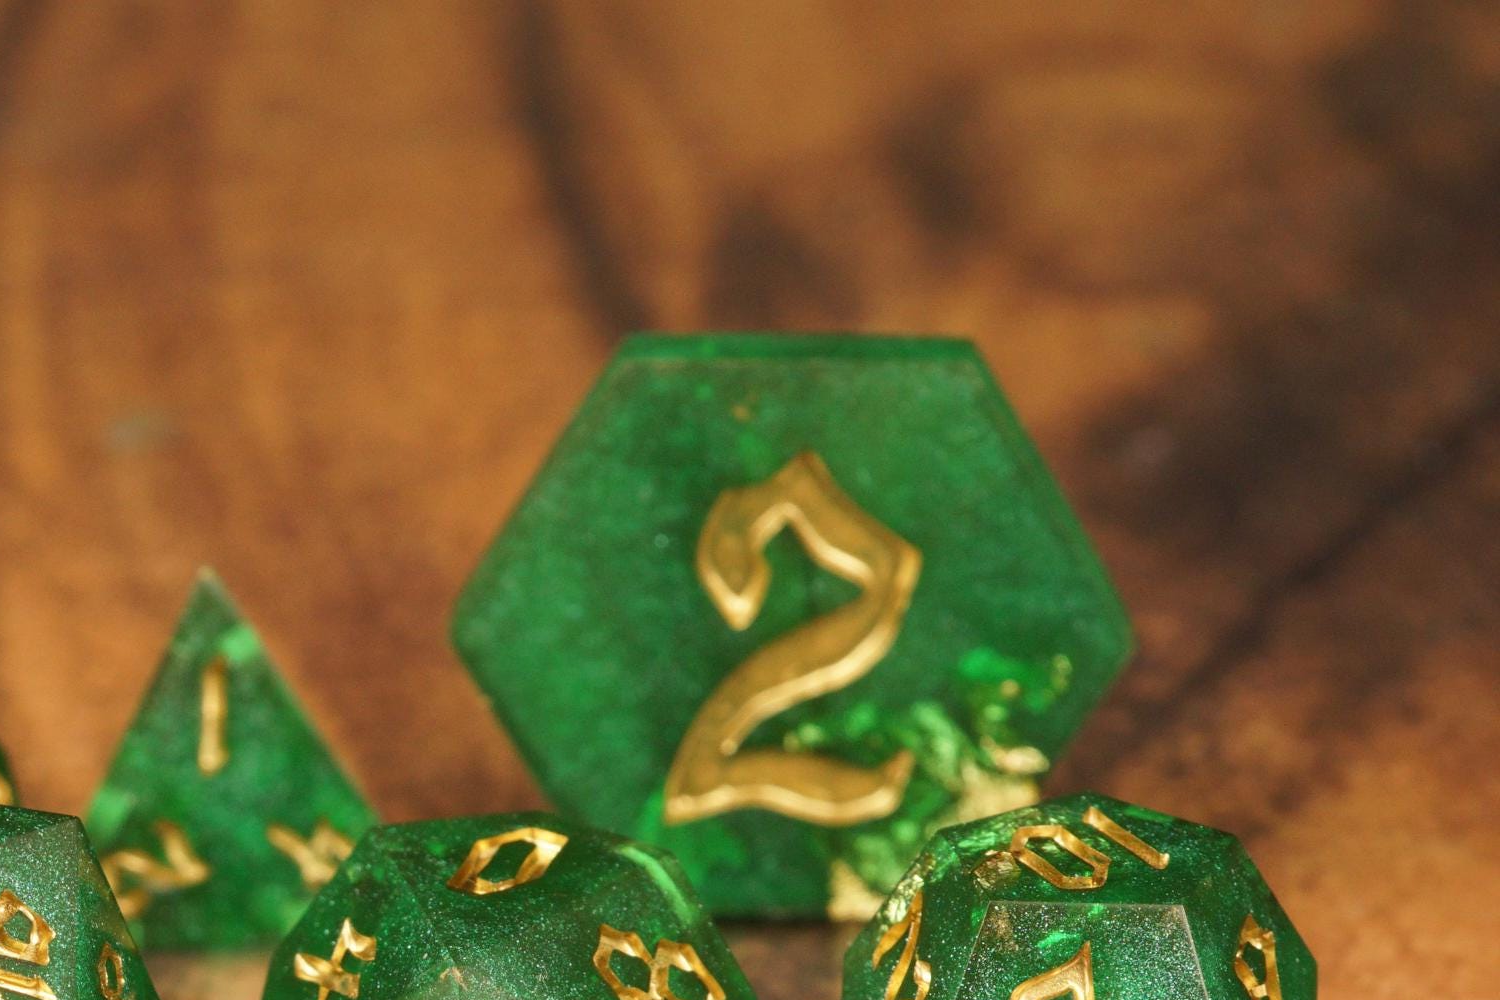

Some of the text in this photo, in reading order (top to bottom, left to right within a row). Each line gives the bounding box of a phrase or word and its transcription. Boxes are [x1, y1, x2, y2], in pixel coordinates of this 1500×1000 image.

[662, 450, 923, 826] 2
[198, 656, 229, 776] 1
[446, 826, 569, 896] 0
[1010, 806, 1170, 889] 10
